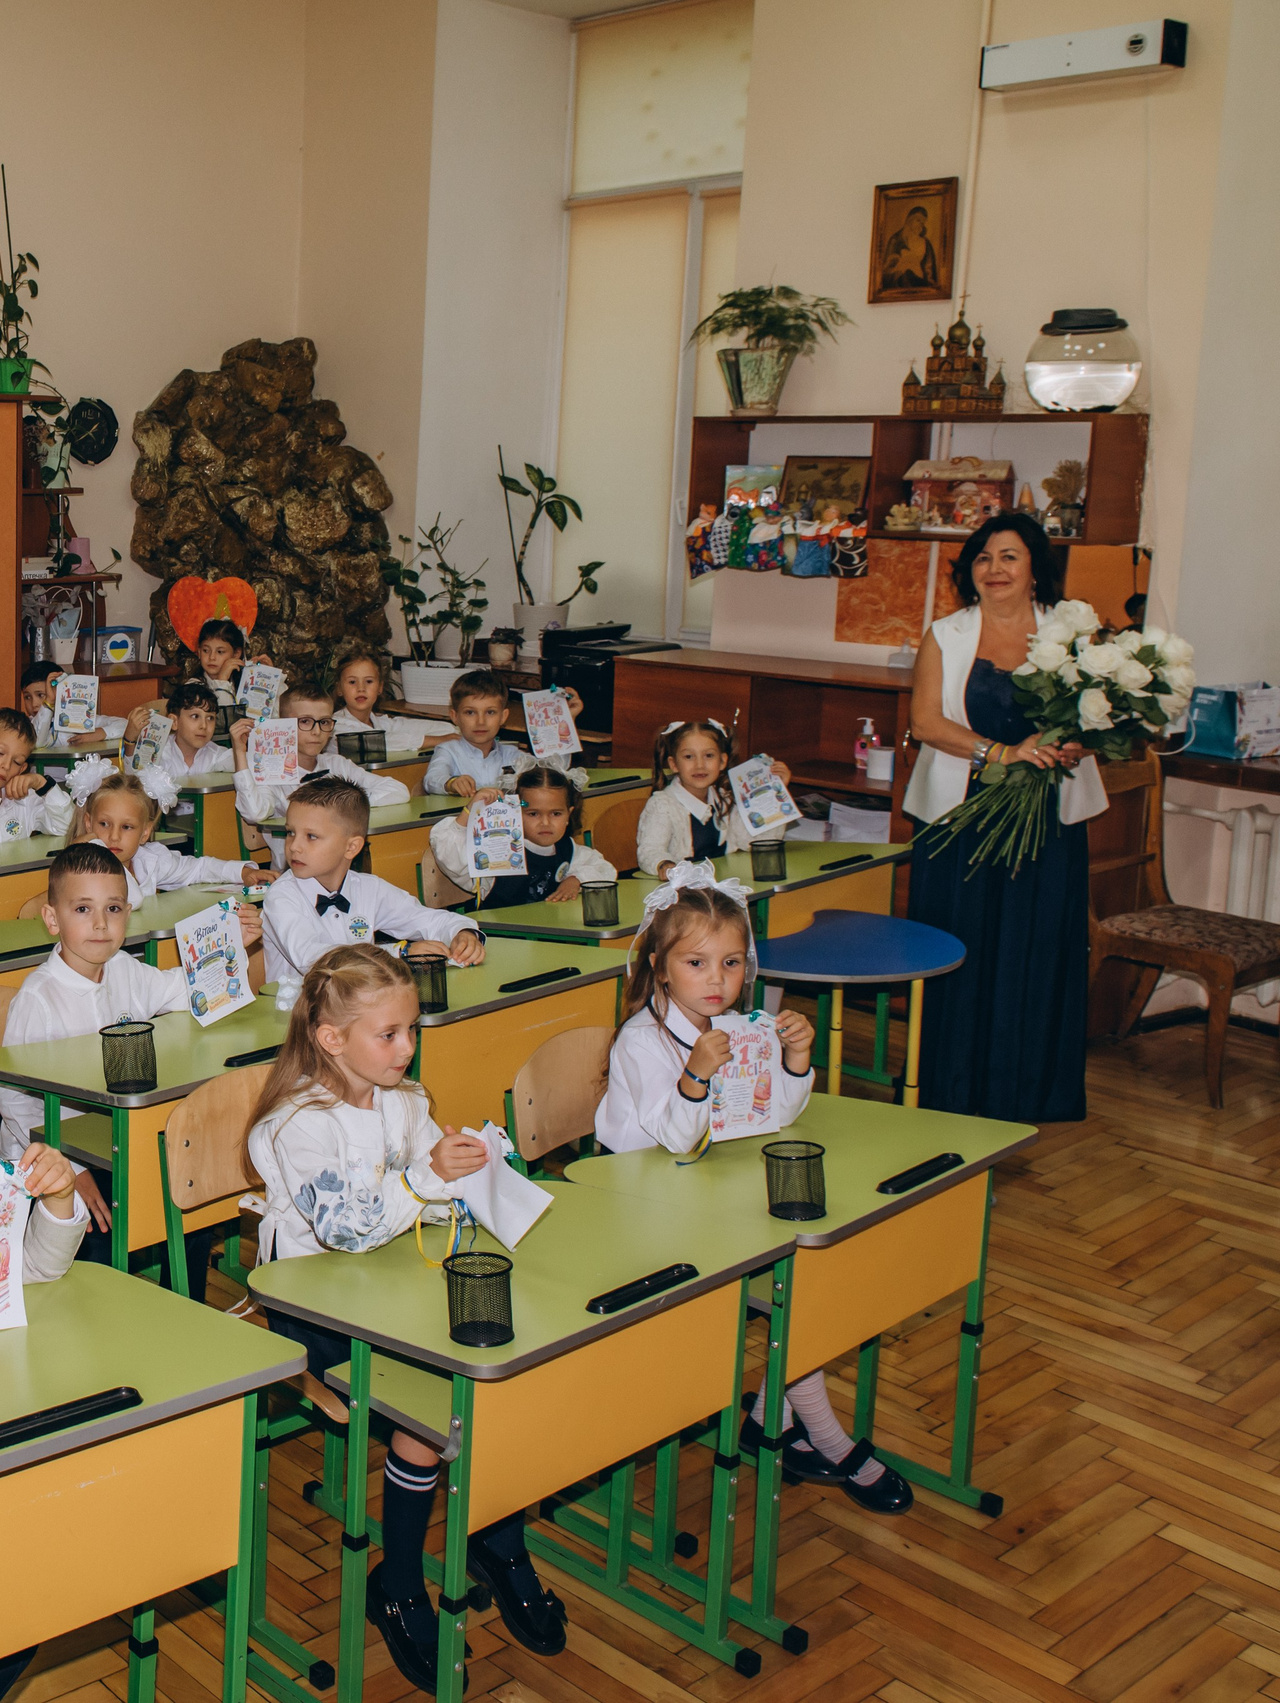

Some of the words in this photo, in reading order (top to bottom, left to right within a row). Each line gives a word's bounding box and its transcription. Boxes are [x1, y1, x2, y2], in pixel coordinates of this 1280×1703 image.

[250, 676, 254, 685] 1
[65, 688, 71, 698] 1
[542, 708, 550, 719] 1
[273, 737, 280, 748] 1
[478, 817, 486, 831] 1
[194, 924, 217, 943] Вітаю
[188, 944, 198, 963] 1
[739, 1045, 749, 1065] 1
